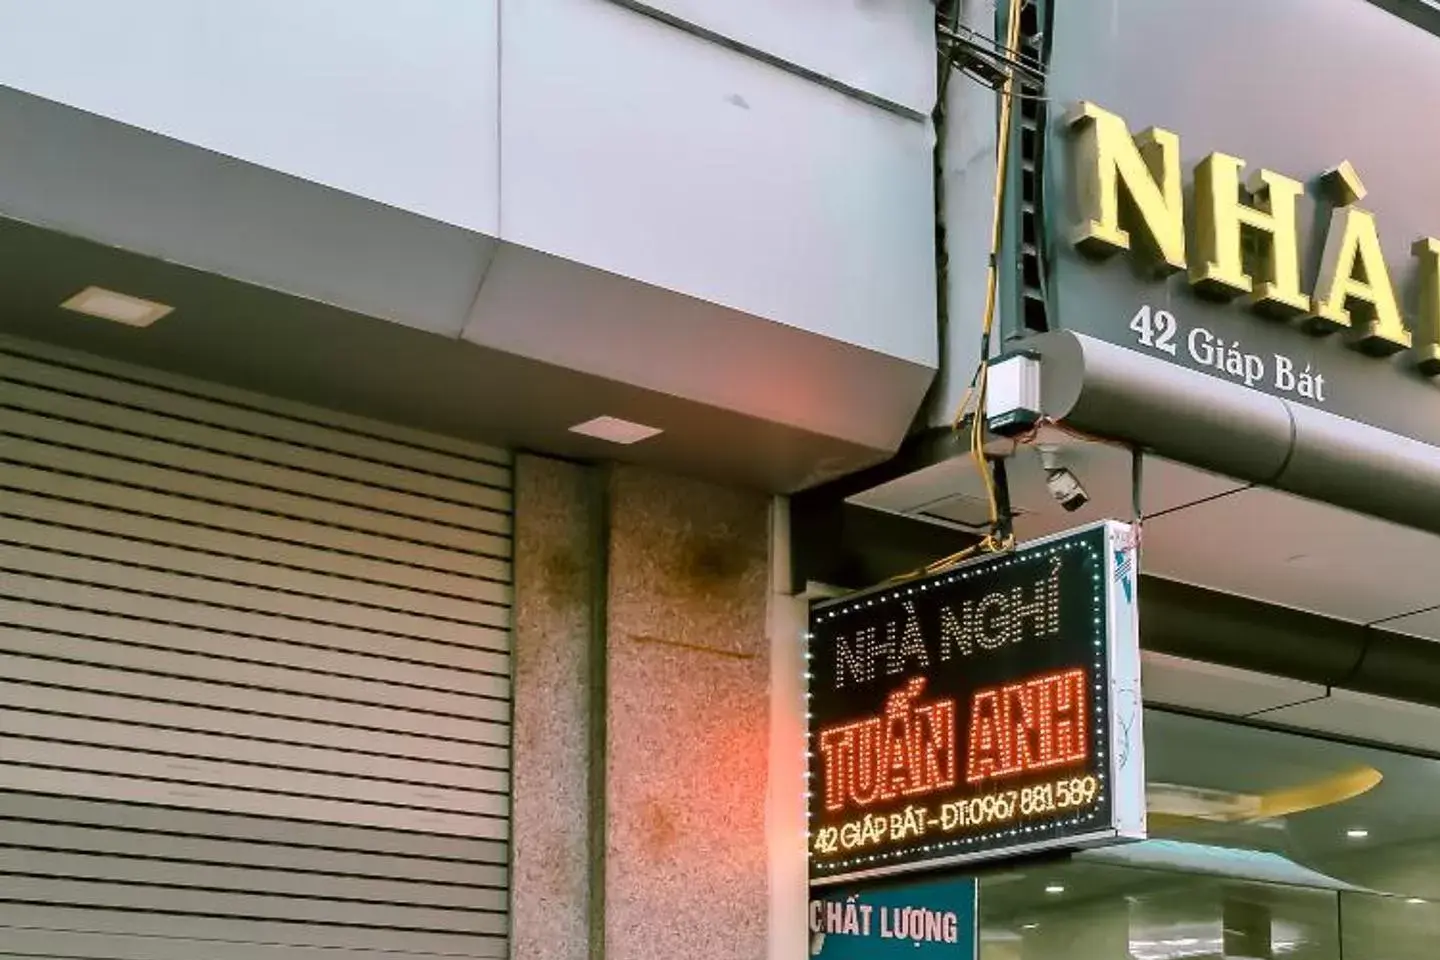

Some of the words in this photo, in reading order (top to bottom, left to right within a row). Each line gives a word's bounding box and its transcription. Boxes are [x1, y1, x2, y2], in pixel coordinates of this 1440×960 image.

[1066, 101, 1413, 351] NHÀ
[1130, 305, 1177, 357] 42
[1188, 327, 1264, 387] Giáp
[1274, 352, 1326, 402] Bát
[836, 601, 930, 688] NHÀ
[941, 555, 1061, 661] NGHỈ
[820, 677, 954, 809] TUẤN
[967, 670, 1086, 782] ANH
[814, 828, 838, 853] 42
[840, 814, 887, 848] GIÁP
[890, 805, 927, 840] BÁT
[1021, 783, 1053, 815] 881
[1056, 776, 1097, 809] 589
[810, 894, 872, 935] CHẤT
[880, 906, 957, 947] LƯỢNG
